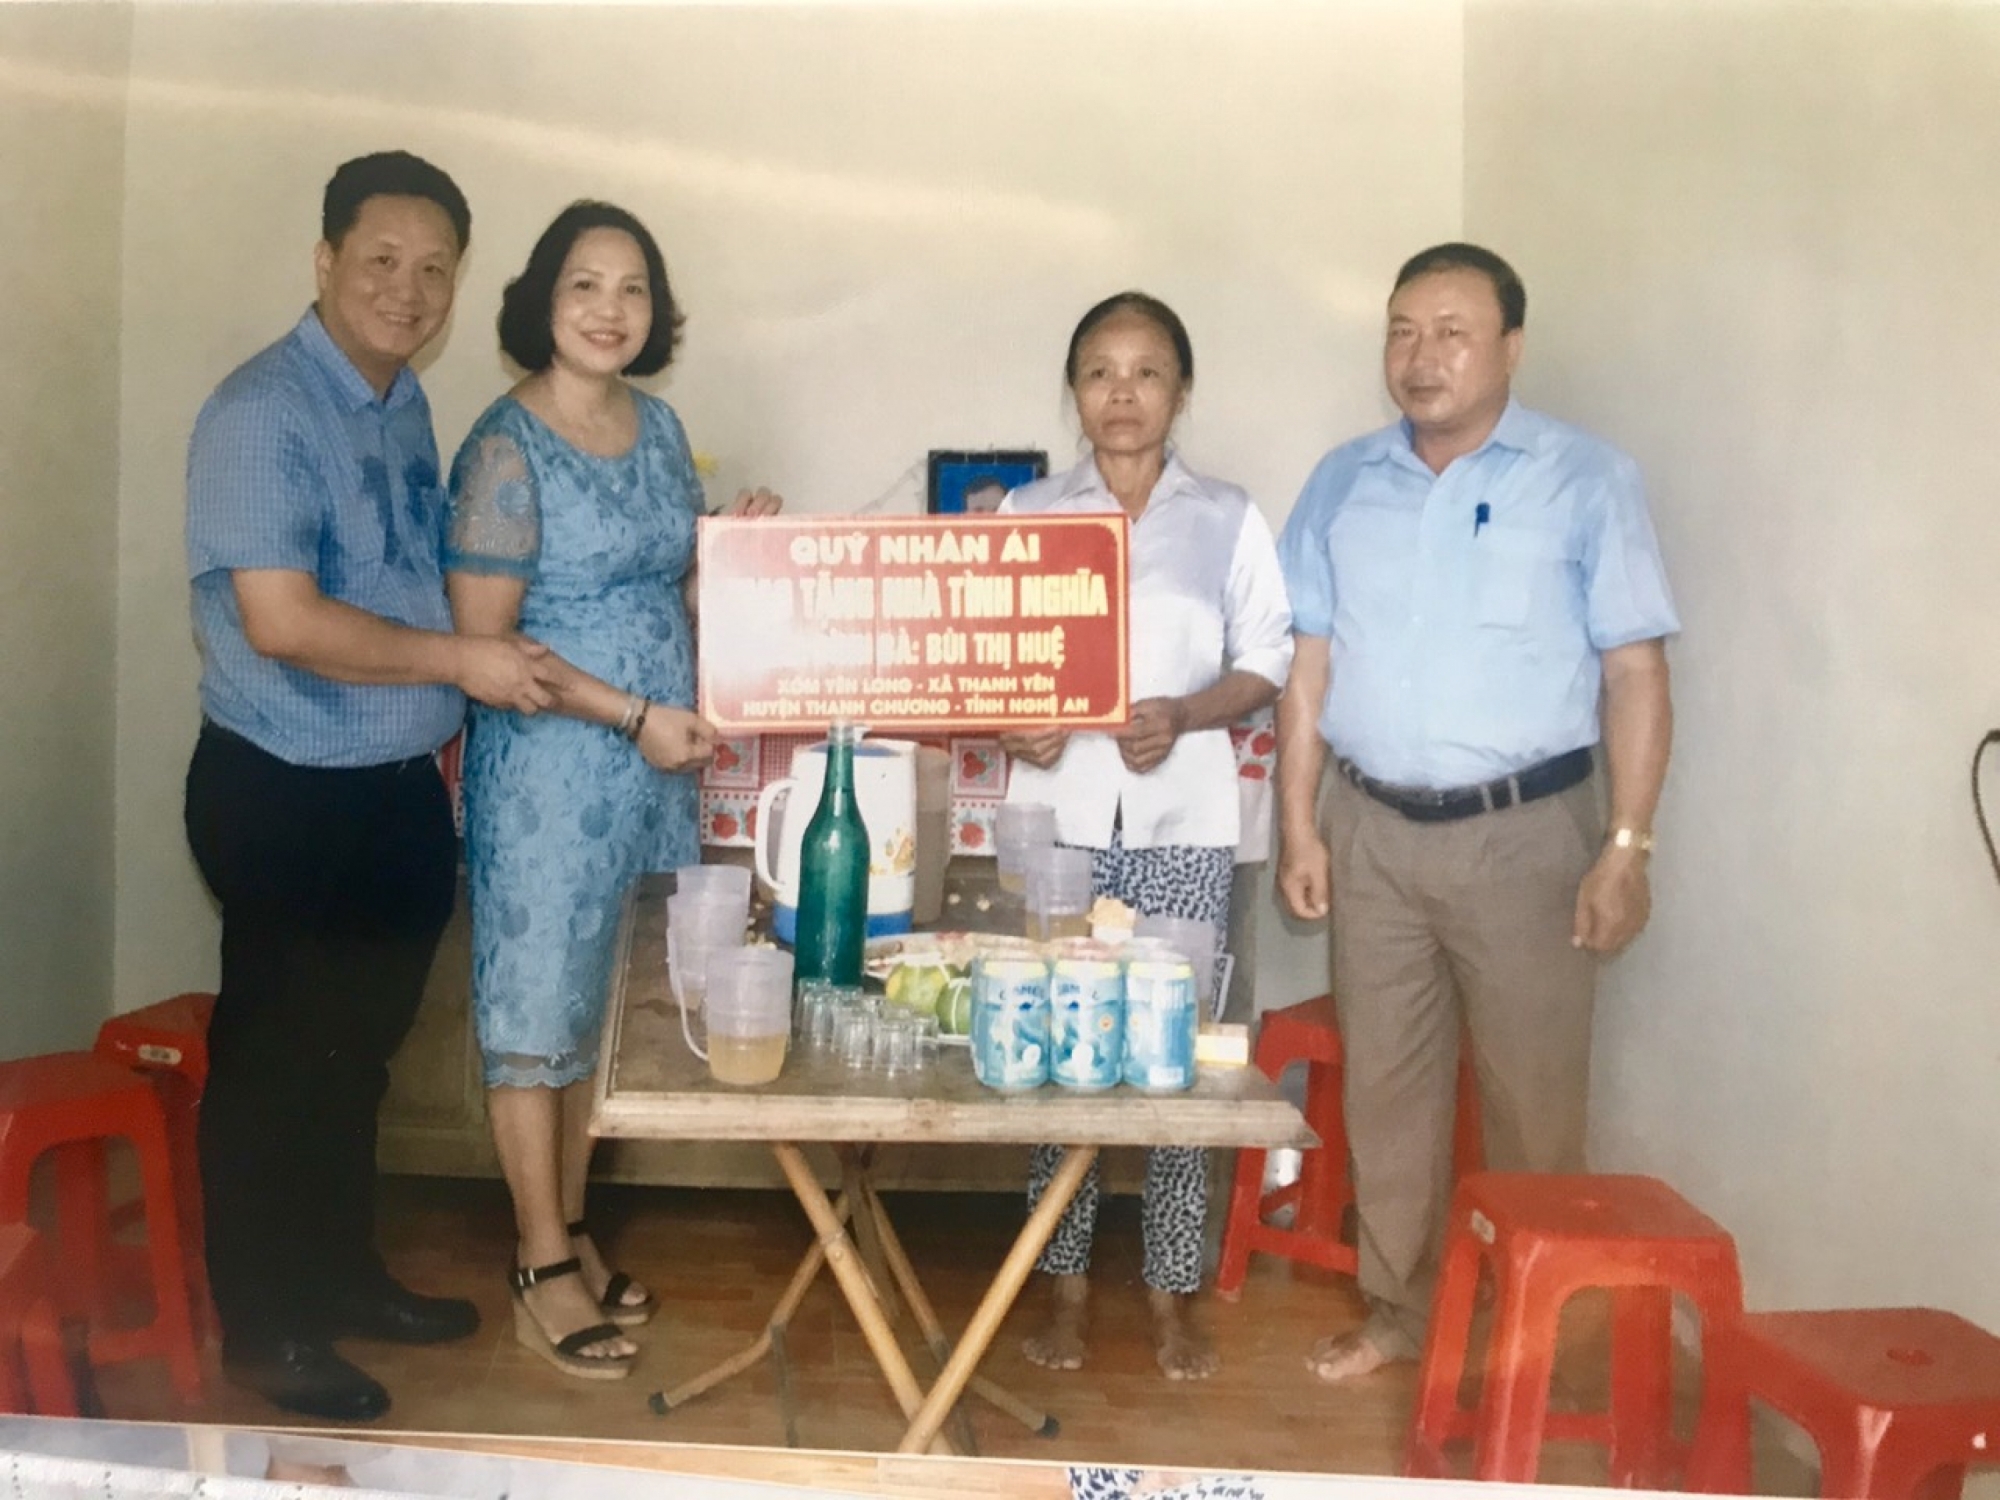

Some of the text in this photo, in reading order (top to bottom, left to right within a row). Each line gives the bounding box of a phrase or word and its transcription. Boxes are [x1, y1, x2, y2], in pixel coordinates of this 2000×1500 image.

[879, 530, 990, 565] NHÂN
[1001, 528, 1040, 563] ÁI
[881, 569, 942, 619] NHÀ
[947, 569, 1013, 619] TÌNH
[1020, 567, 1109, 618] NGHĨA
[925, 626, 968, 666] BÙI
[973, 632, 1012, 671] THỊ
[1017, 624, 1066, 670] HUỆ
[957, 676, 1018, 693] THANH
[1022, 672, 1055, 692] YÊN
[805, 699, 865, 716] THANH
[1009, 693, 1058, 717] NGHỆ
[1063, 697, 1089, 713] AN
